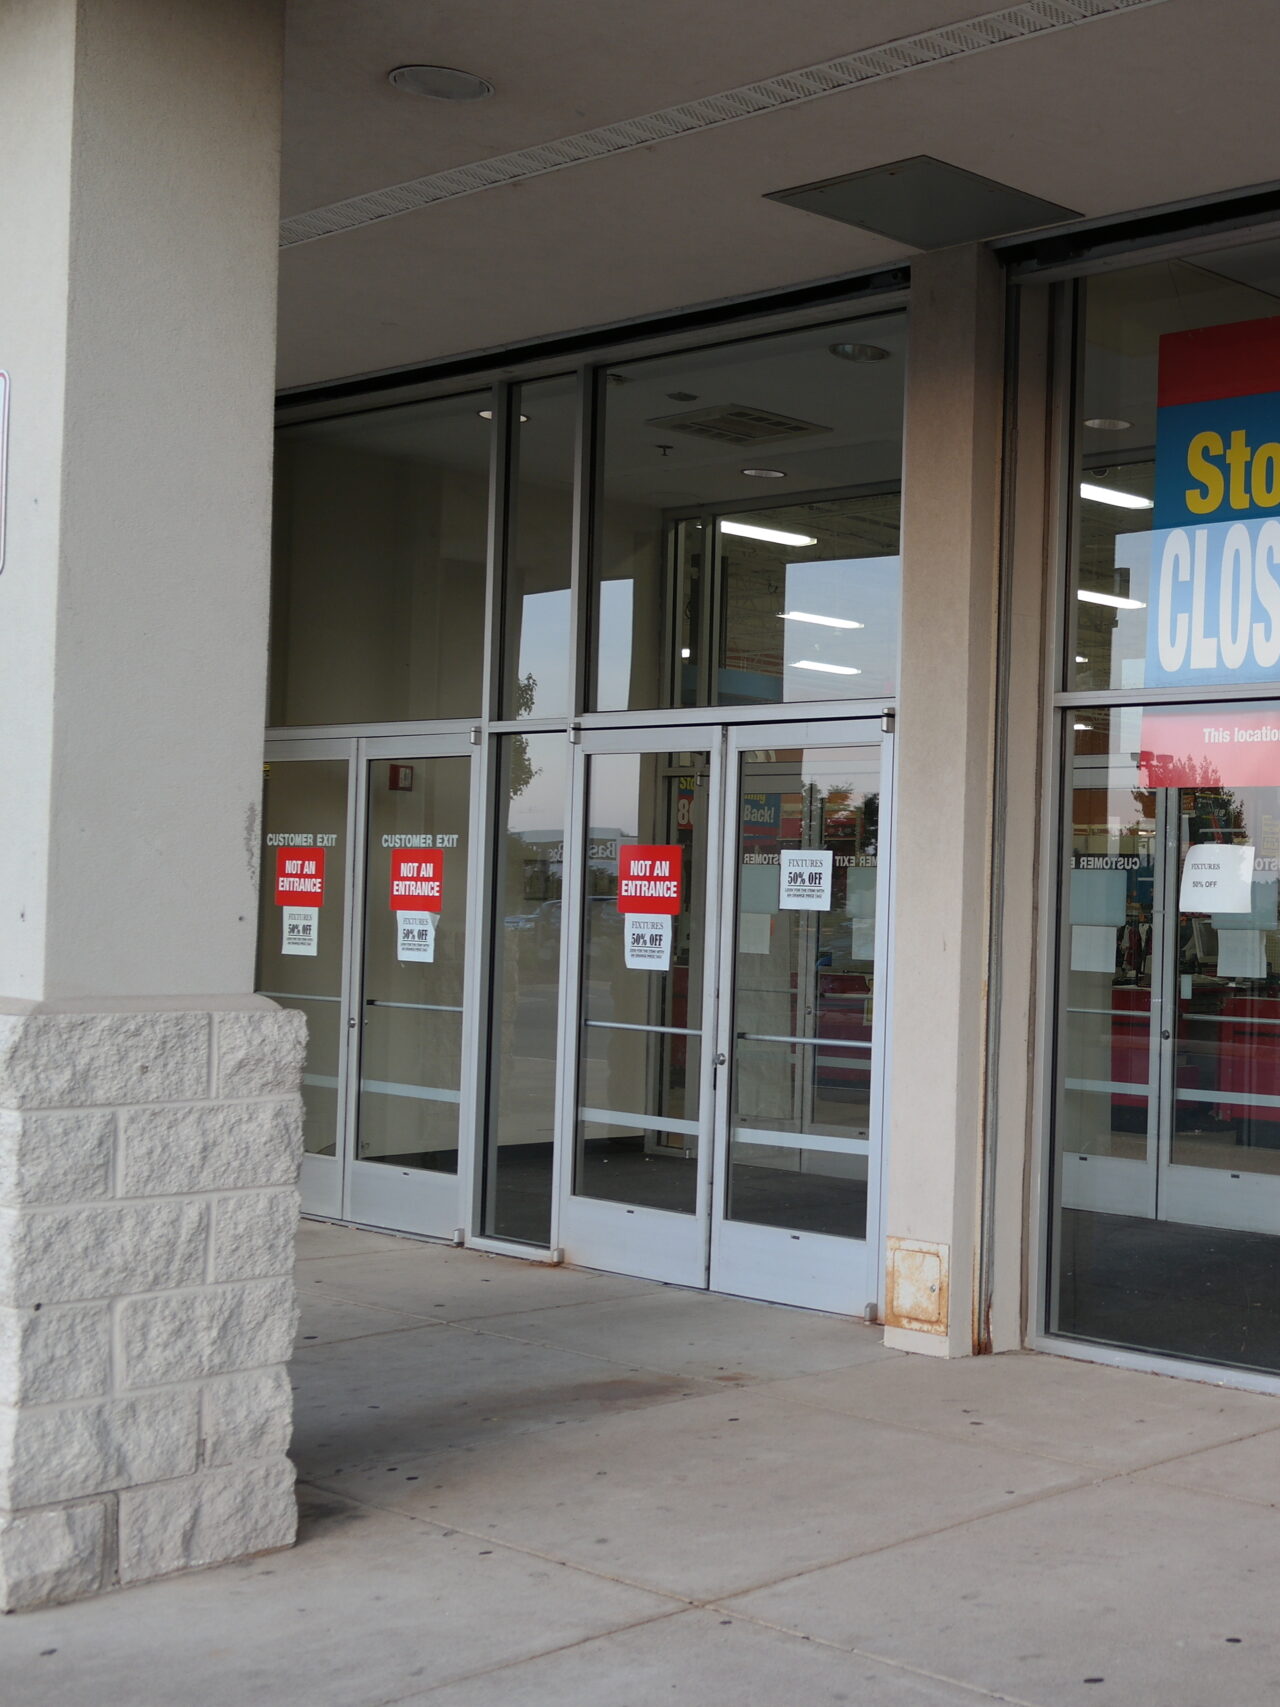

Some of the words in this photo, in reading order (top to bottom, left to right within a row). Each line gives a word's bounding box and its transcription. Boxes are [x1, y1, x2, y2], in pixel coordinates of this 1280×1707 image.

[1203, 727, 1230, 743] This
[744, 806, 775, 823] Back!
[267, 834, 313, 846] CUSTOMER
[317, 834, 337, 847] EXIT
[382, 834, 432, 847] CUSTOMER
[436, 834, 459, 847] EXIT
[286, 860, 301, 874] NOT
[303, 861, 316, 875] AN
[400, 862, 417, 877] NOT
[420, 863, 433, 877] AN
[630, 860, 651, 876] NOT
[654, 861, 669, 876] AN
[788, 859, 823, 868] FIXTURES
[278, 878, 322, 892] ENTRANCE
[787, 871, 805, 885] 50%
[808, 872, 822, 885] OFF
[393, 881, 440, 896] ENTRANCE
[622, 880, 677, 897] ENTRANCE
[288, 924, 300, 936] 50%
[302, 925, 312, 936] OFF
[631, 921, 663, 930] FIXTURES
[402, 929, 415, 940] 50%
[417, 929, 427, 941] OFF
[631, 933, 647, 946] 50%
[649, 934, 663, 947] OFF
